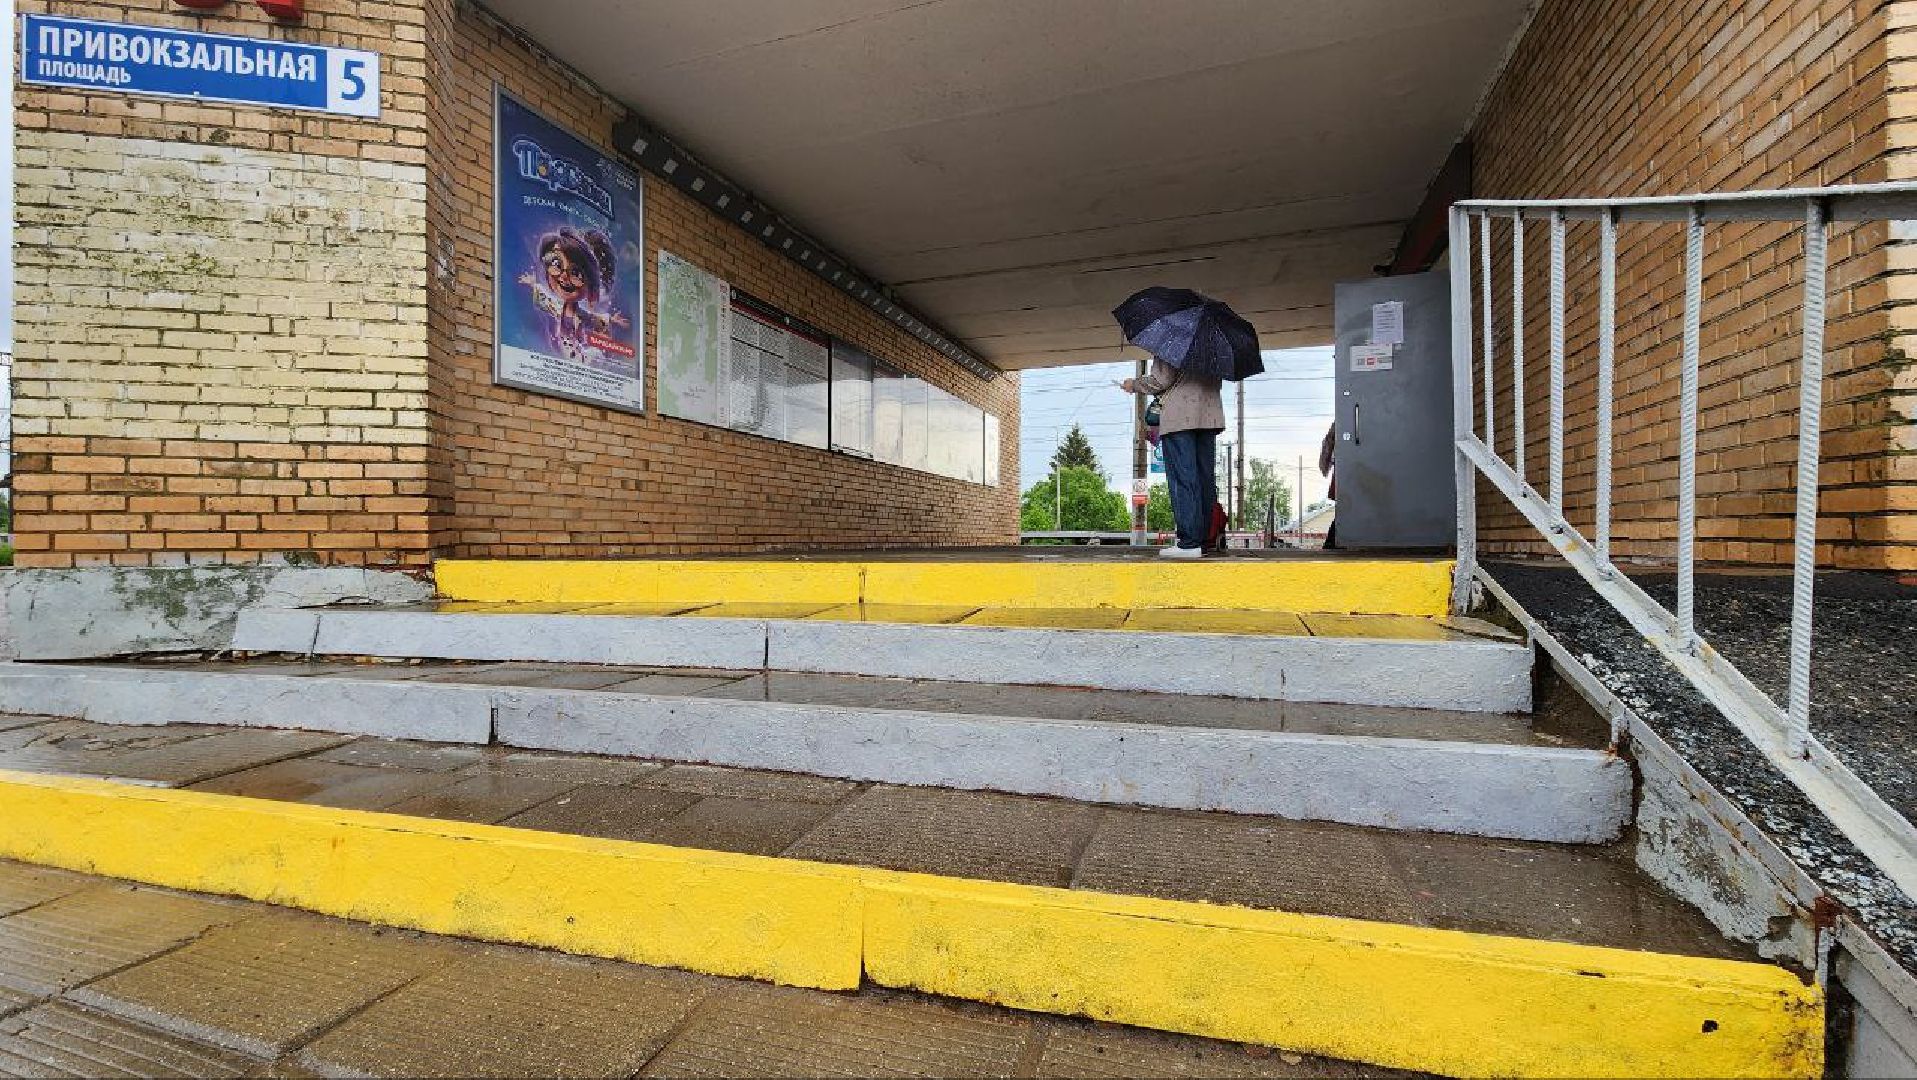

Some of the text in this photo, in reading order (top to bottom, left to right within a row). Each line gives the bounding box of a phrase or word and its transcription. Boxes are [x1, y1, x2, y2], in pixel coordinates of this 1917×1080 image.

[38, 25, 317, 82] ПРИВОКЗАЛЬНАЯ
[38, 59, 132, 86] ПЛОЩАДЬ
[340, 59, 367, 101] 5
